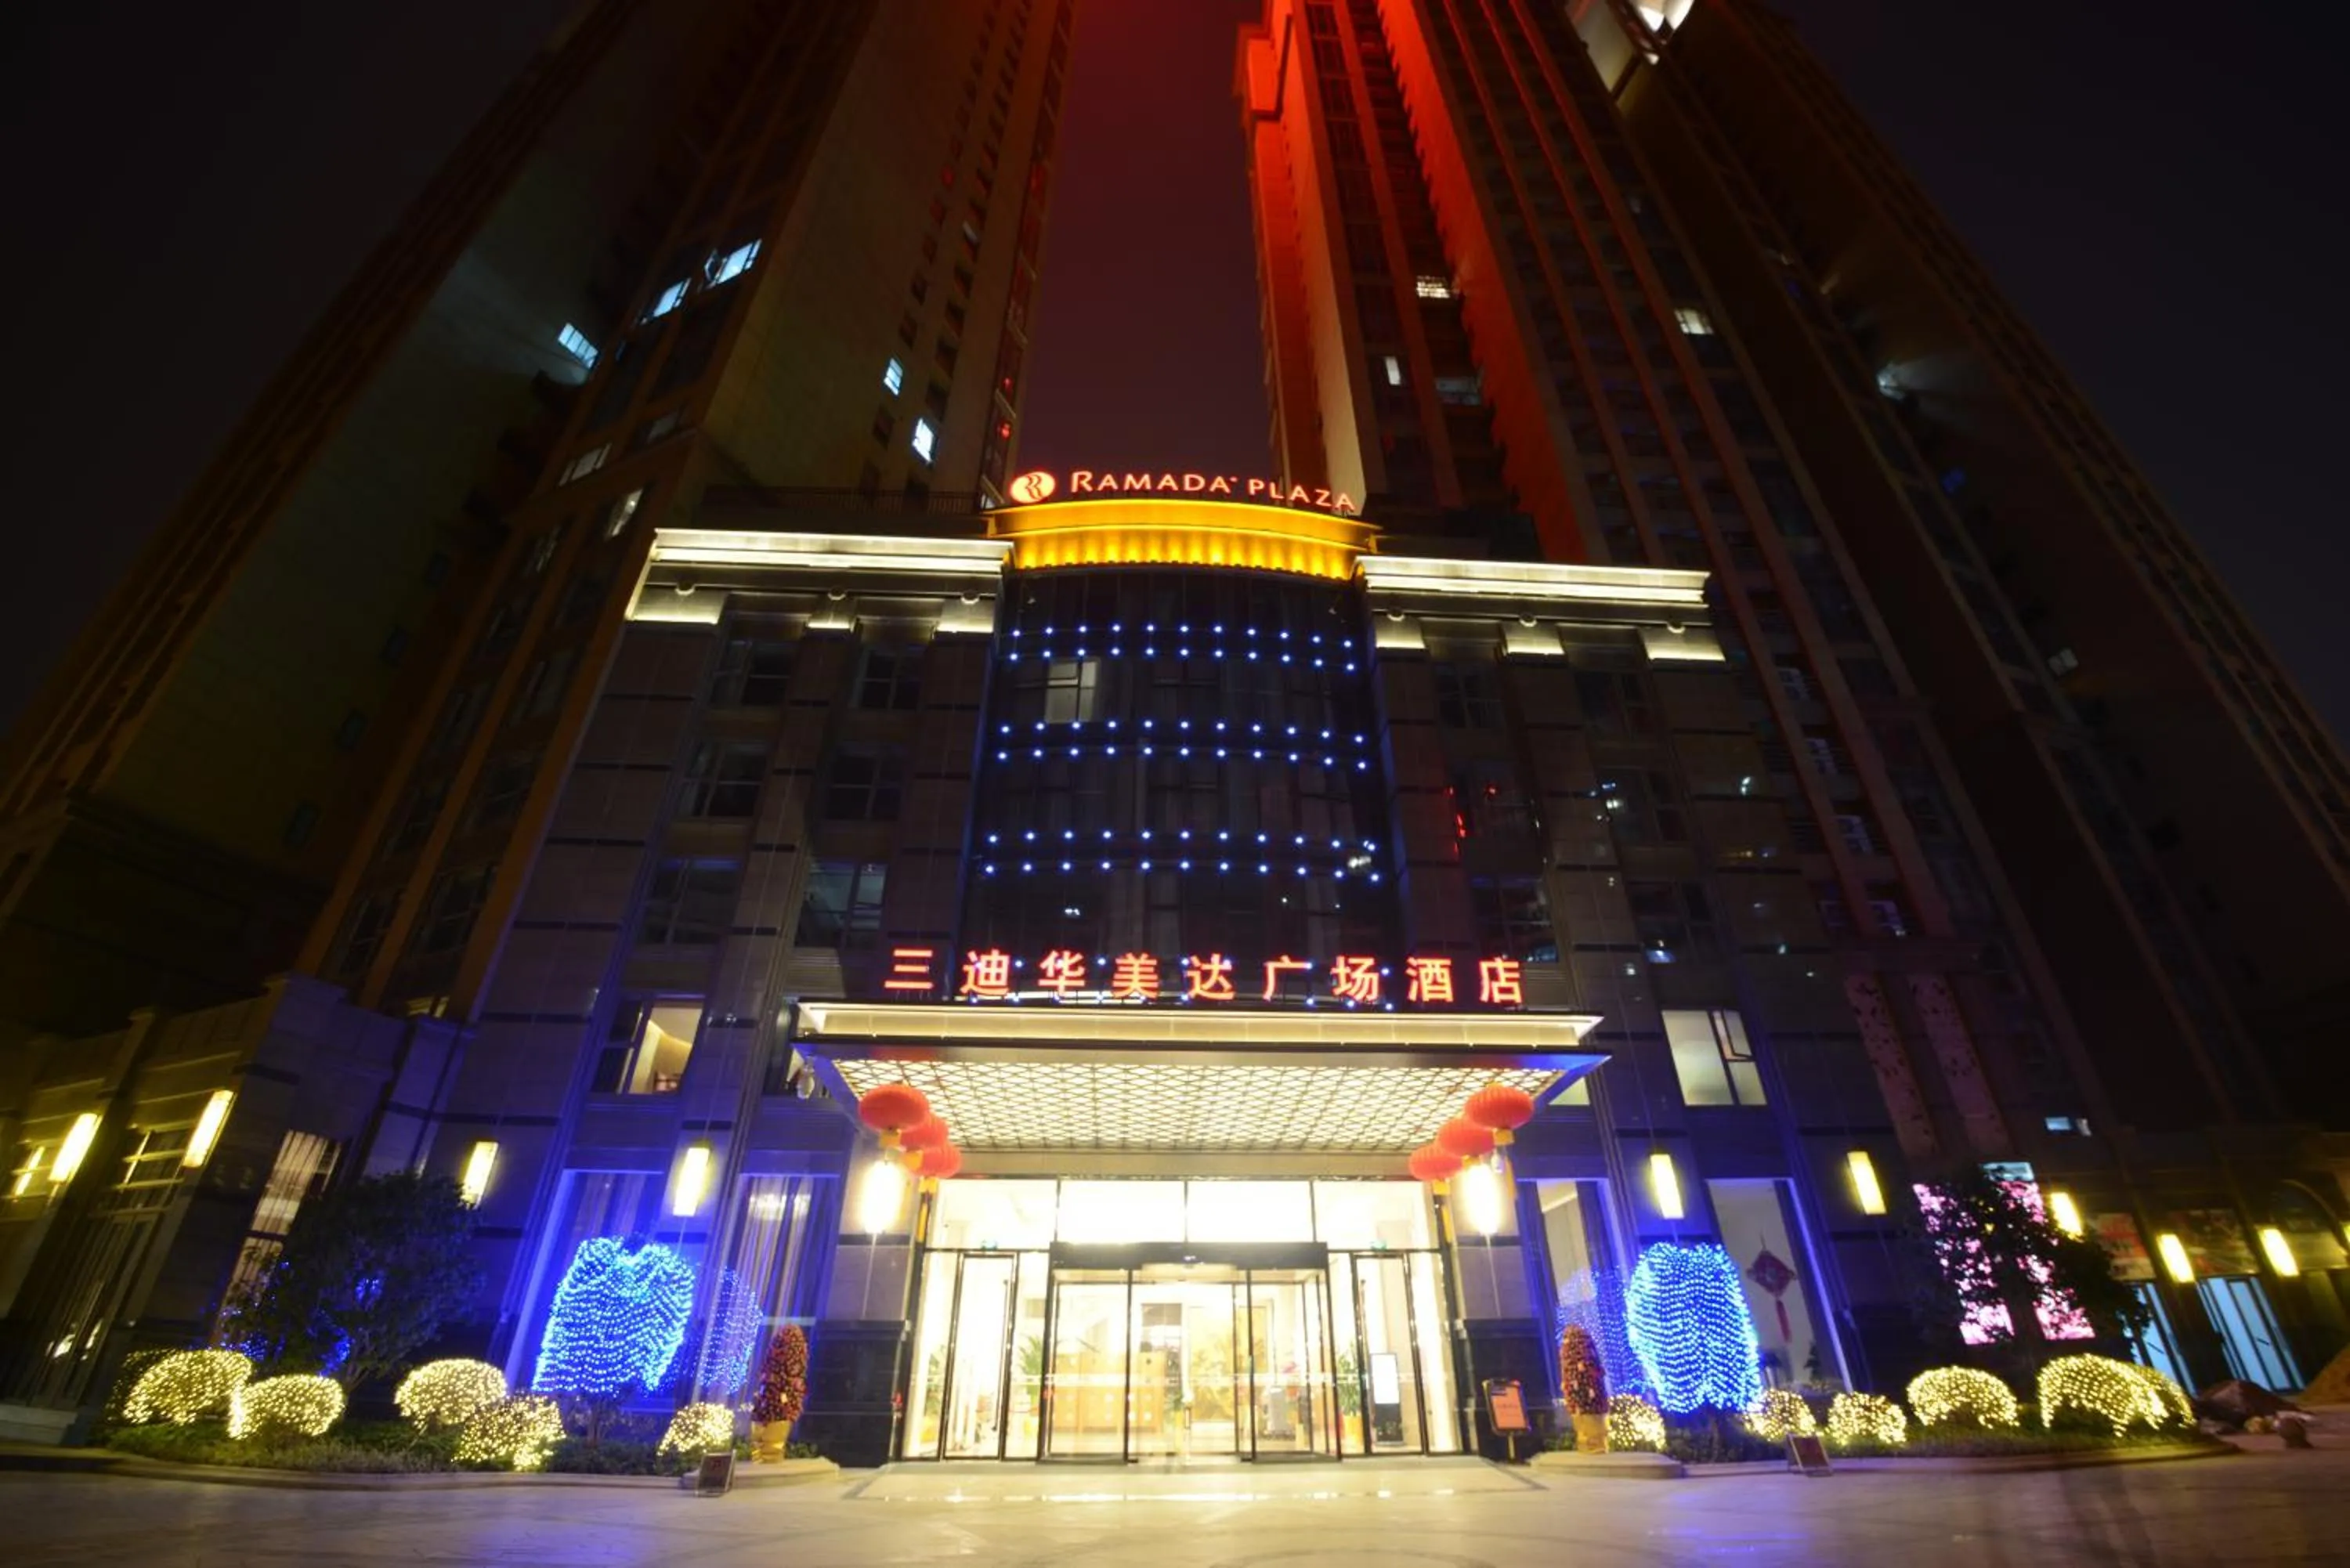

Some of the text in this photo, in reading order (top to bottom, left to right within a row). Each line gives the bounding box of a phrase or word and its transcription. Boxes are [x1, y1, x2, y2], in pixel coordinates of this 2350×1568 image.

[1071, 471, 1231, 493] RAMADA
[1248, 478, 1356, 511] PLAZA
[884, 948, 1523, 1003] 三迪华美达广场酒店
